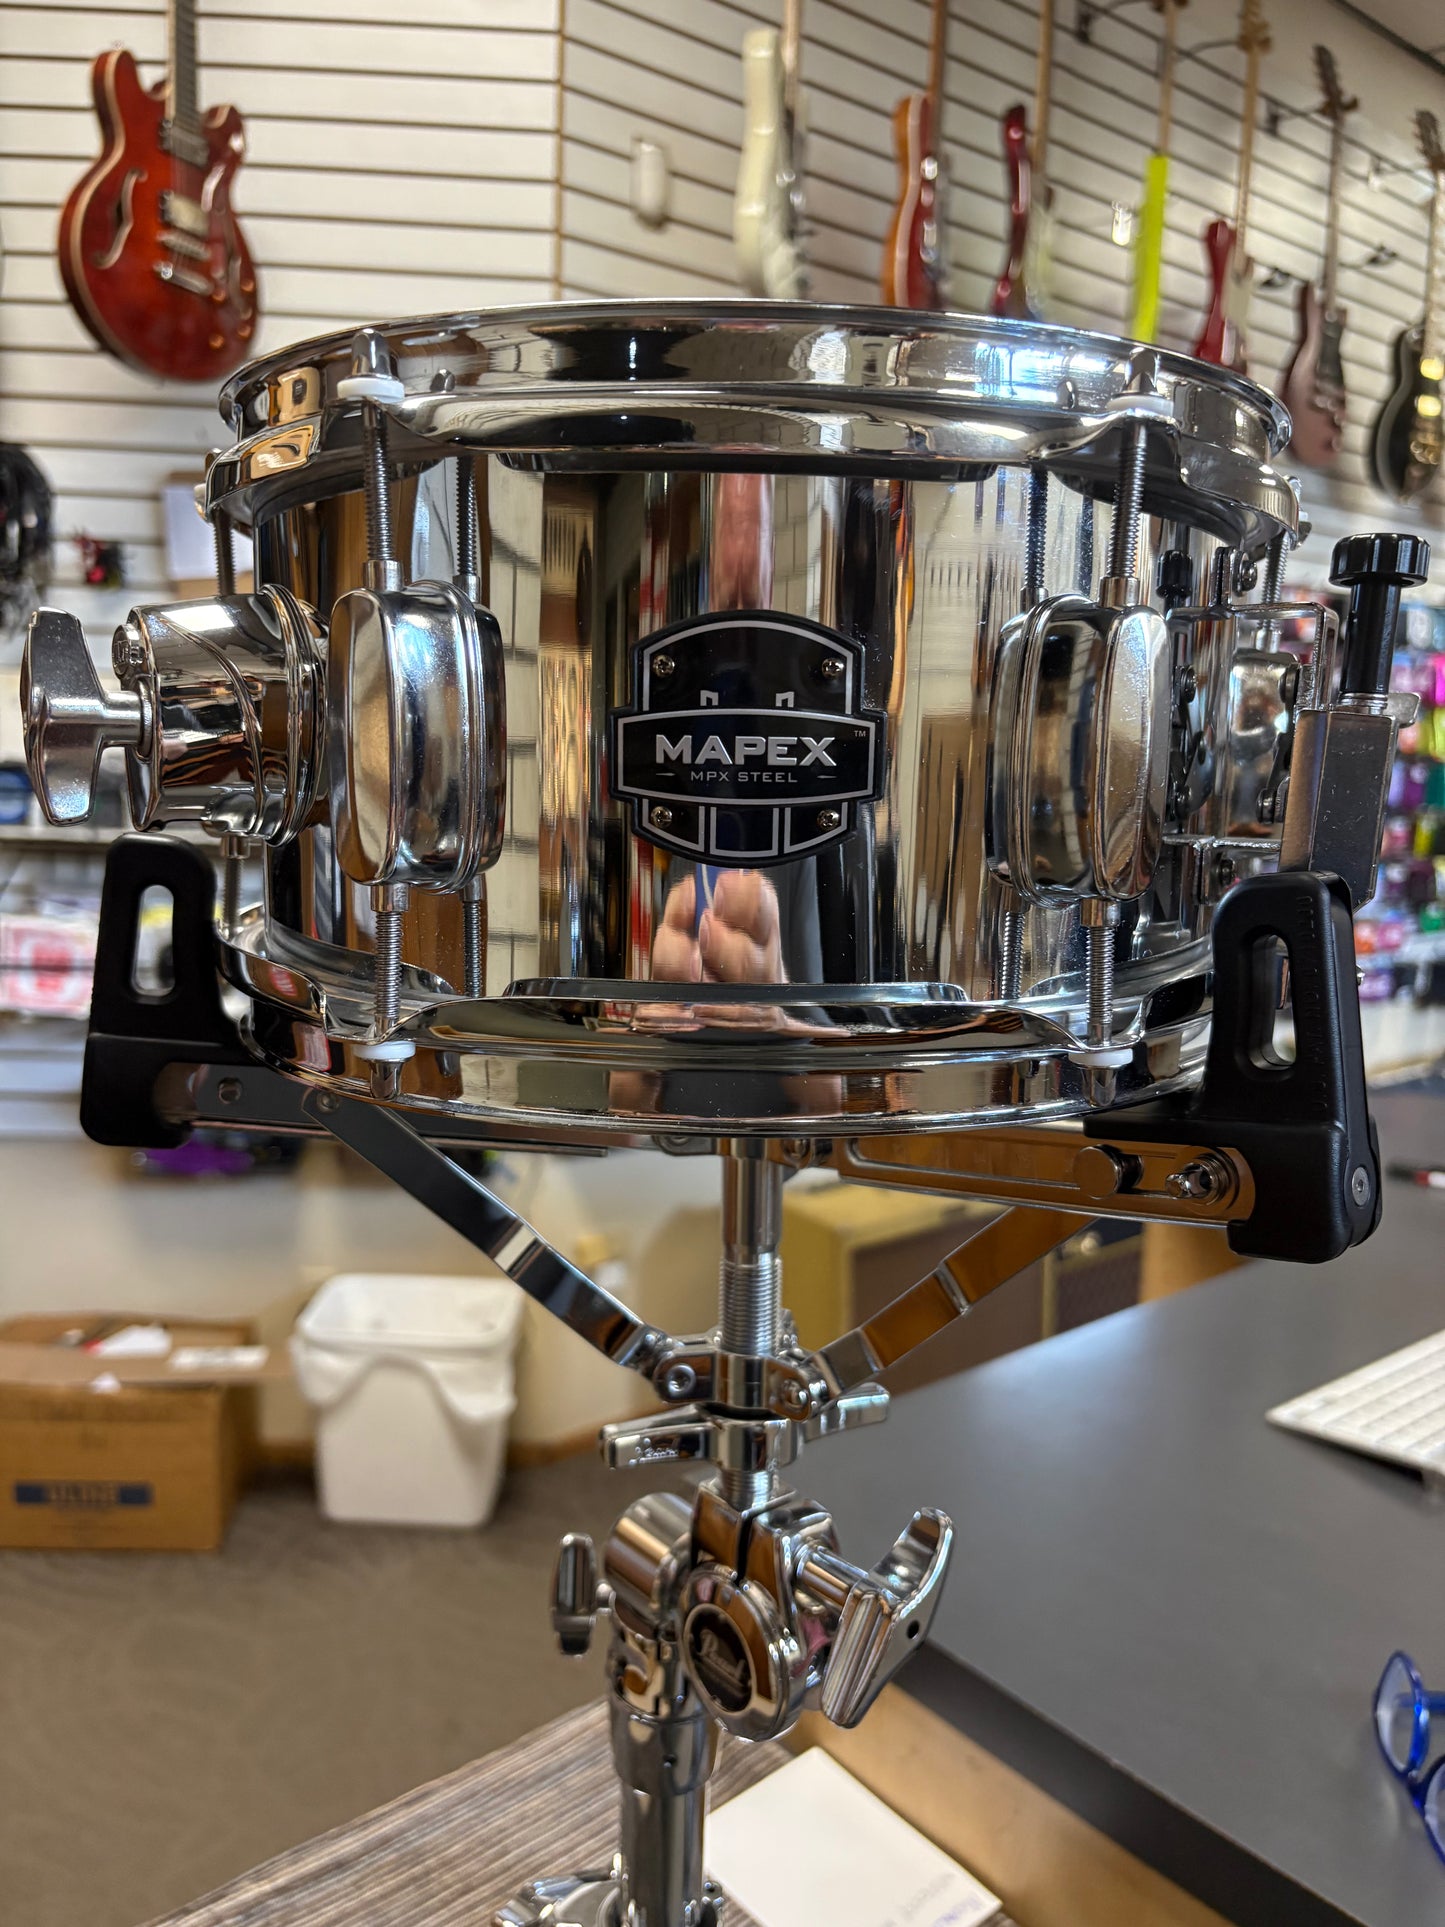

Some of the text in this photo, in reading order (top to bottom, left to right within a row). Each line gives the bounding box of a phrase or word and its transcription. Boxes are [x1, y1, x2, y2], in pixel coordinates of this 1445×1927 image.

[656, 734, 837, 766] MAPEX
[691, 771, 798, 783] MPX STEEL
